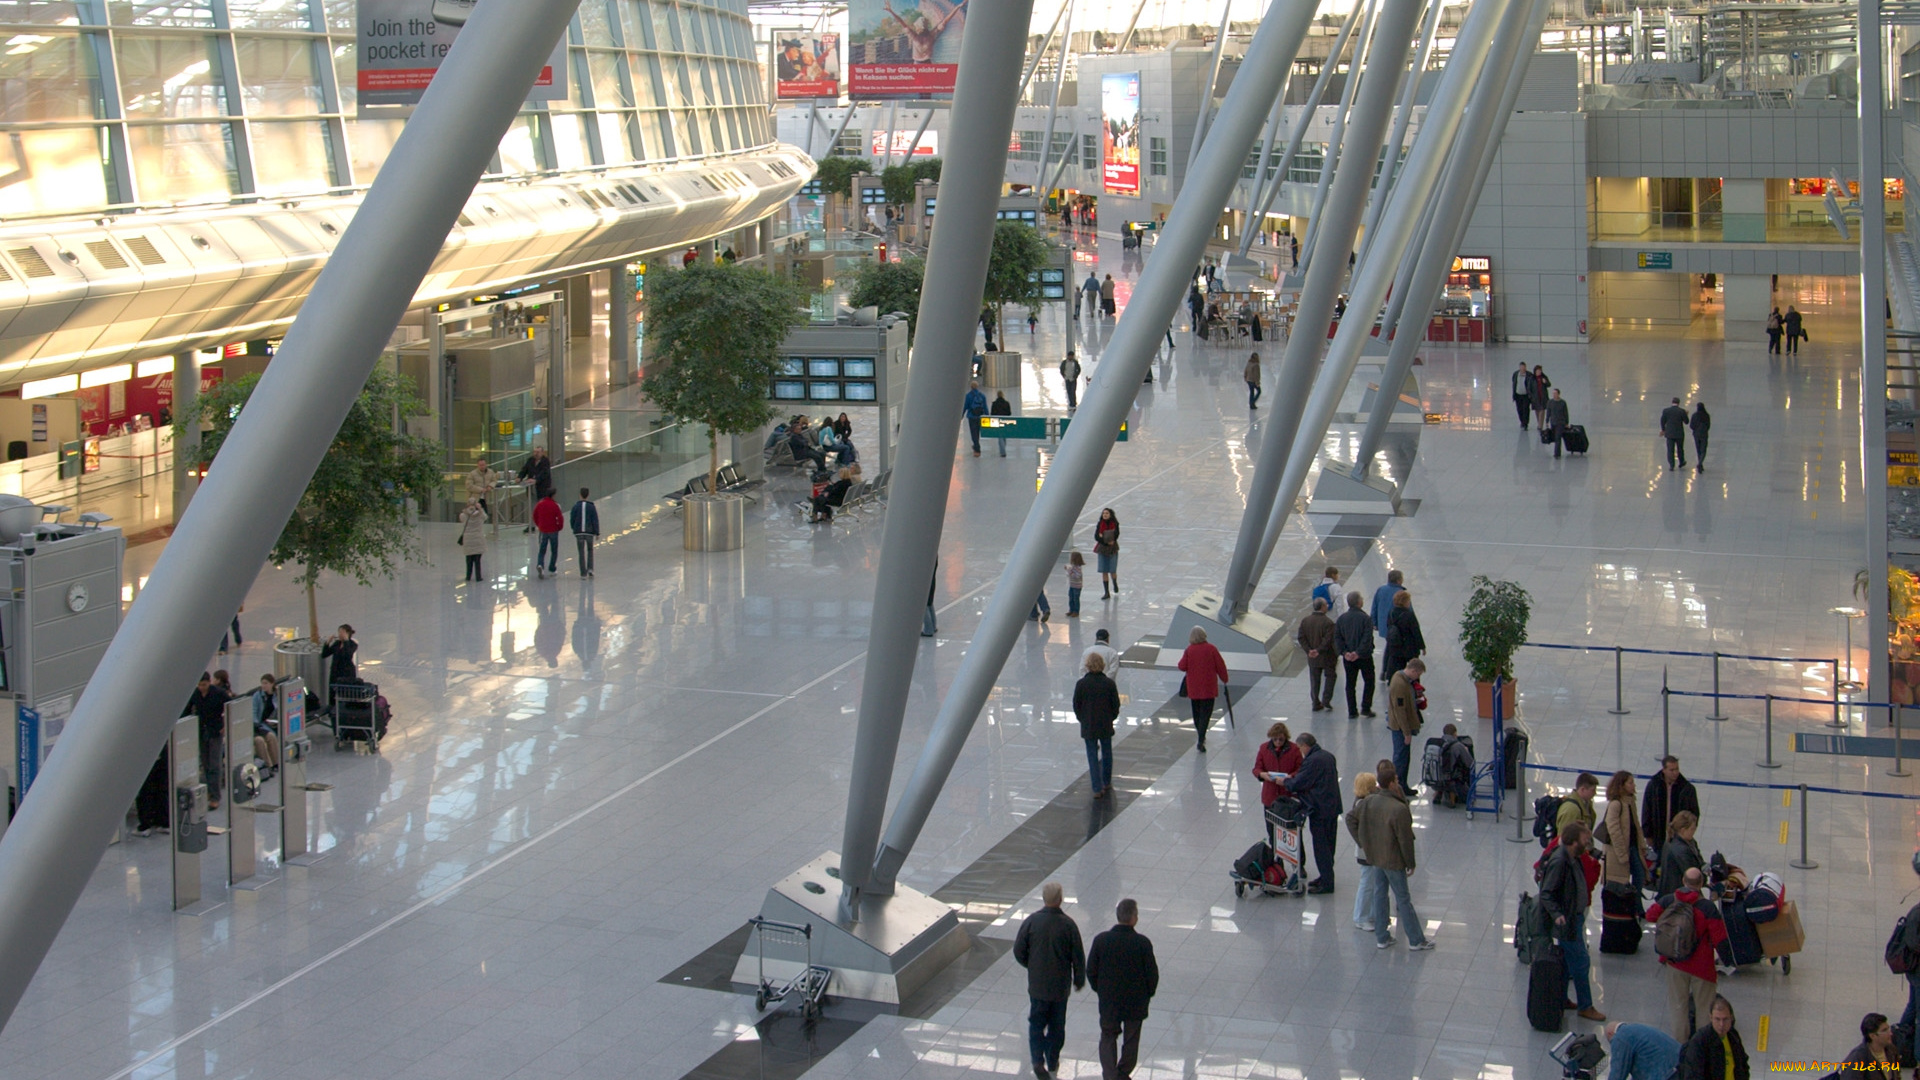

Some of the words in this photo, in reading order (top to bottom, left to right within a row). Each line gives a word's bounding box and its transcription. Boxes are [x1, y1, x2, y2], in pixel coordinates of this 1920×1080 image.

[367, 19, 402, 37] Join
[409, 18, 435, 36] the
[368, 42, 426, 63] pocket
